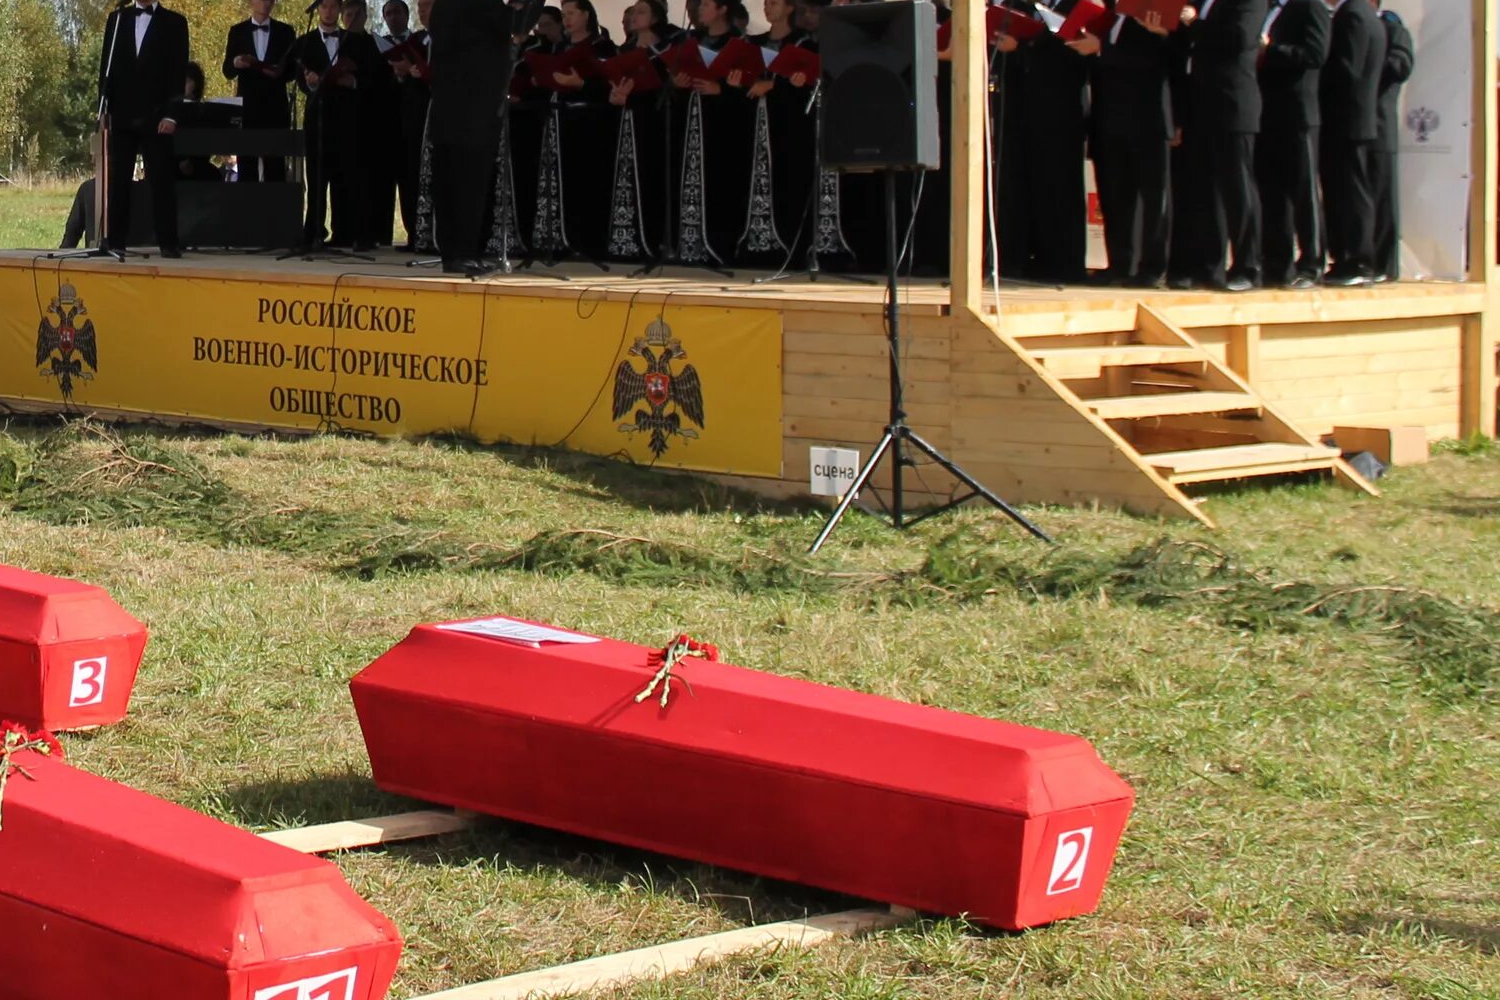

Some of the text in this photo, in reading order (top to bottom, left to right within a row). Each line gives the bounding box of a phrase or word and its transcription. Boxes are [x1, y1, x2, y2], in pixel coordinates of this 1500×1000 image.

[257, 297, 416, 334] РОССИЙСКОЕ
[192, 336, 489, 386] ВОЕННО-ИСТОРИЧЕСКОЕ
[269, 386, 402, 424] ОБЩЕСТВО
[814, 464, 855, 480] сцена
[73, 661, 103, 702] 3
[1051, 832, 1086, 892] 2
